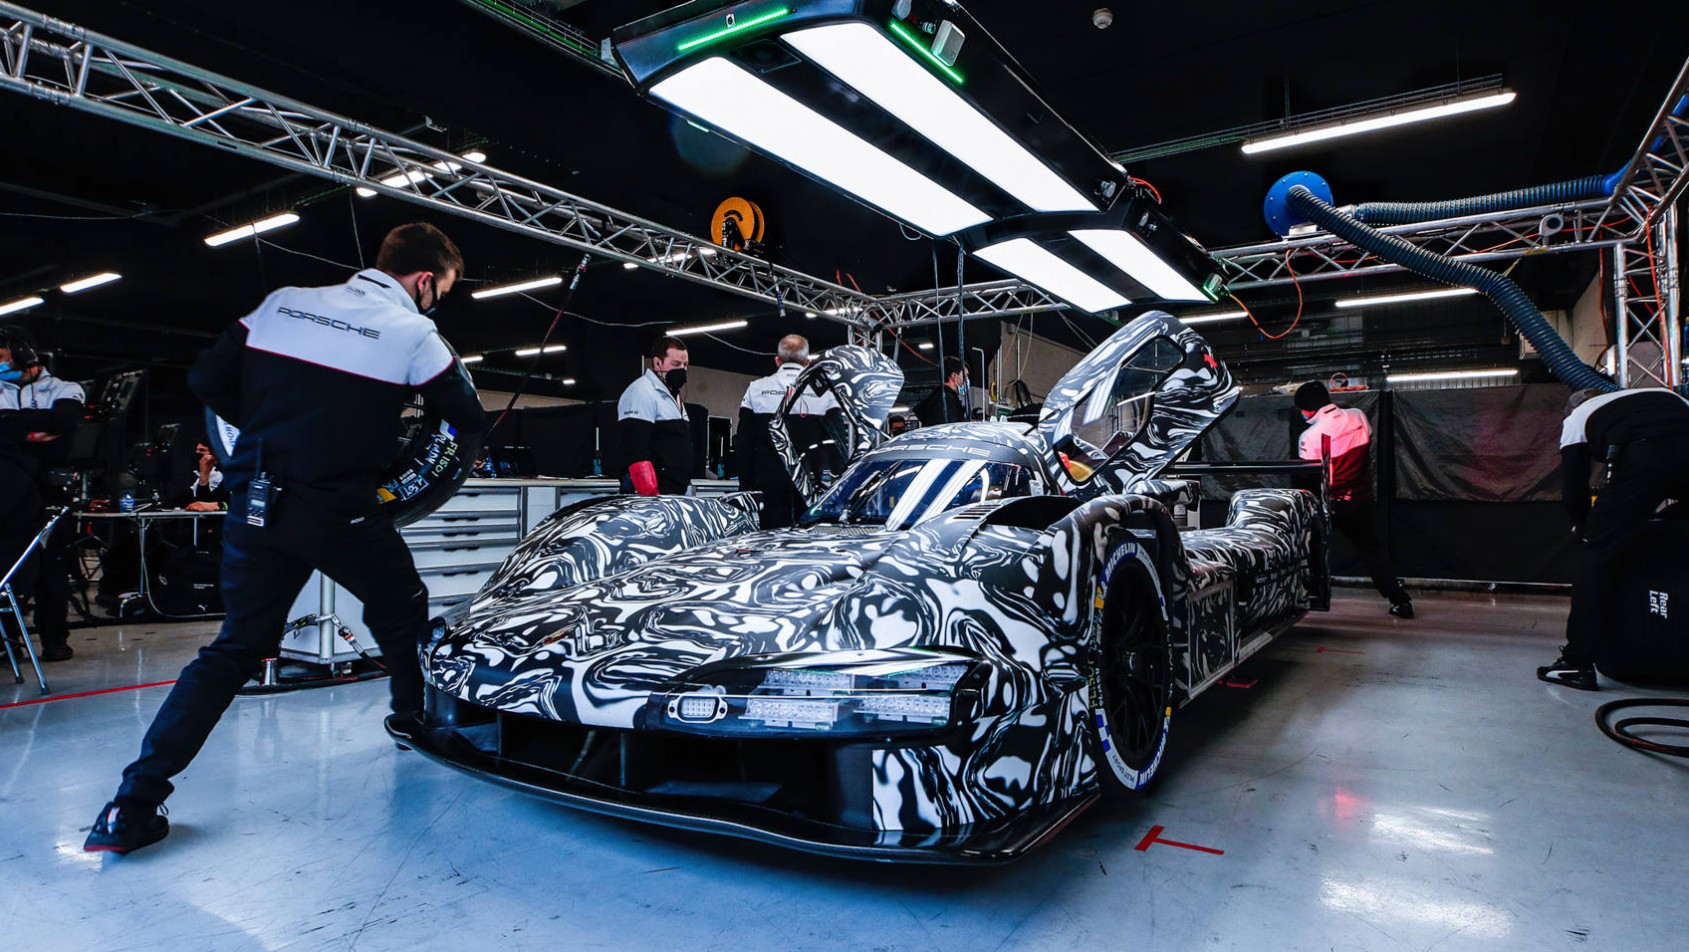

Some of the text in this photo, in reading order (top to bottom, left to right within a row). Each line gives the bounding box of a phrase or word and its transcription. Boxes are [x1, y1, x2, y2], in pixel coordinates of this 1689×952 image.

[277, 306, 381, 340] PORSCHE
[761, 389, 817, 398] PORHE
[1105, 542, 1136, 582] MICHELIN
[1649, 589, 1660, 614] Left
[1659, 592, 1669, 620] Rear
